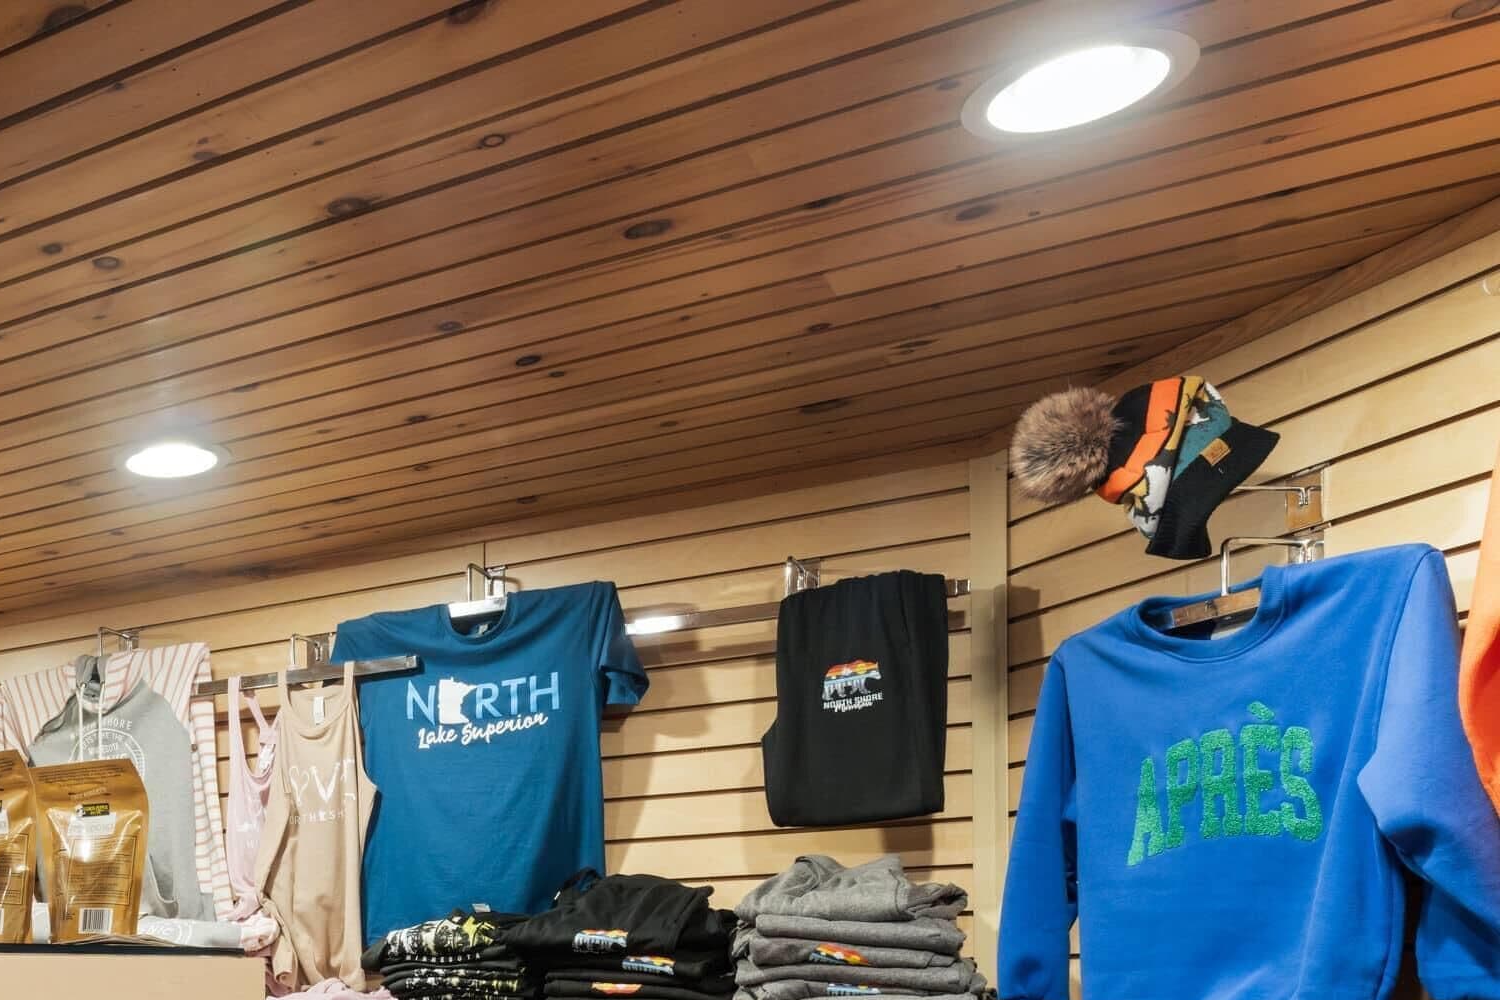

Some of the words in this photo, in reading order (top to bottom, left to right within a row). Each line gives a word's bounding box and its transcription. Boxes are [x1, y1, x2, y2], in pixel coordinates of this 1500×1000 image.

[418, 726, 458, 749] Lake
[461, 712, 548, 745] Superior
[1127, 701, 1323, 866] APRÈS
